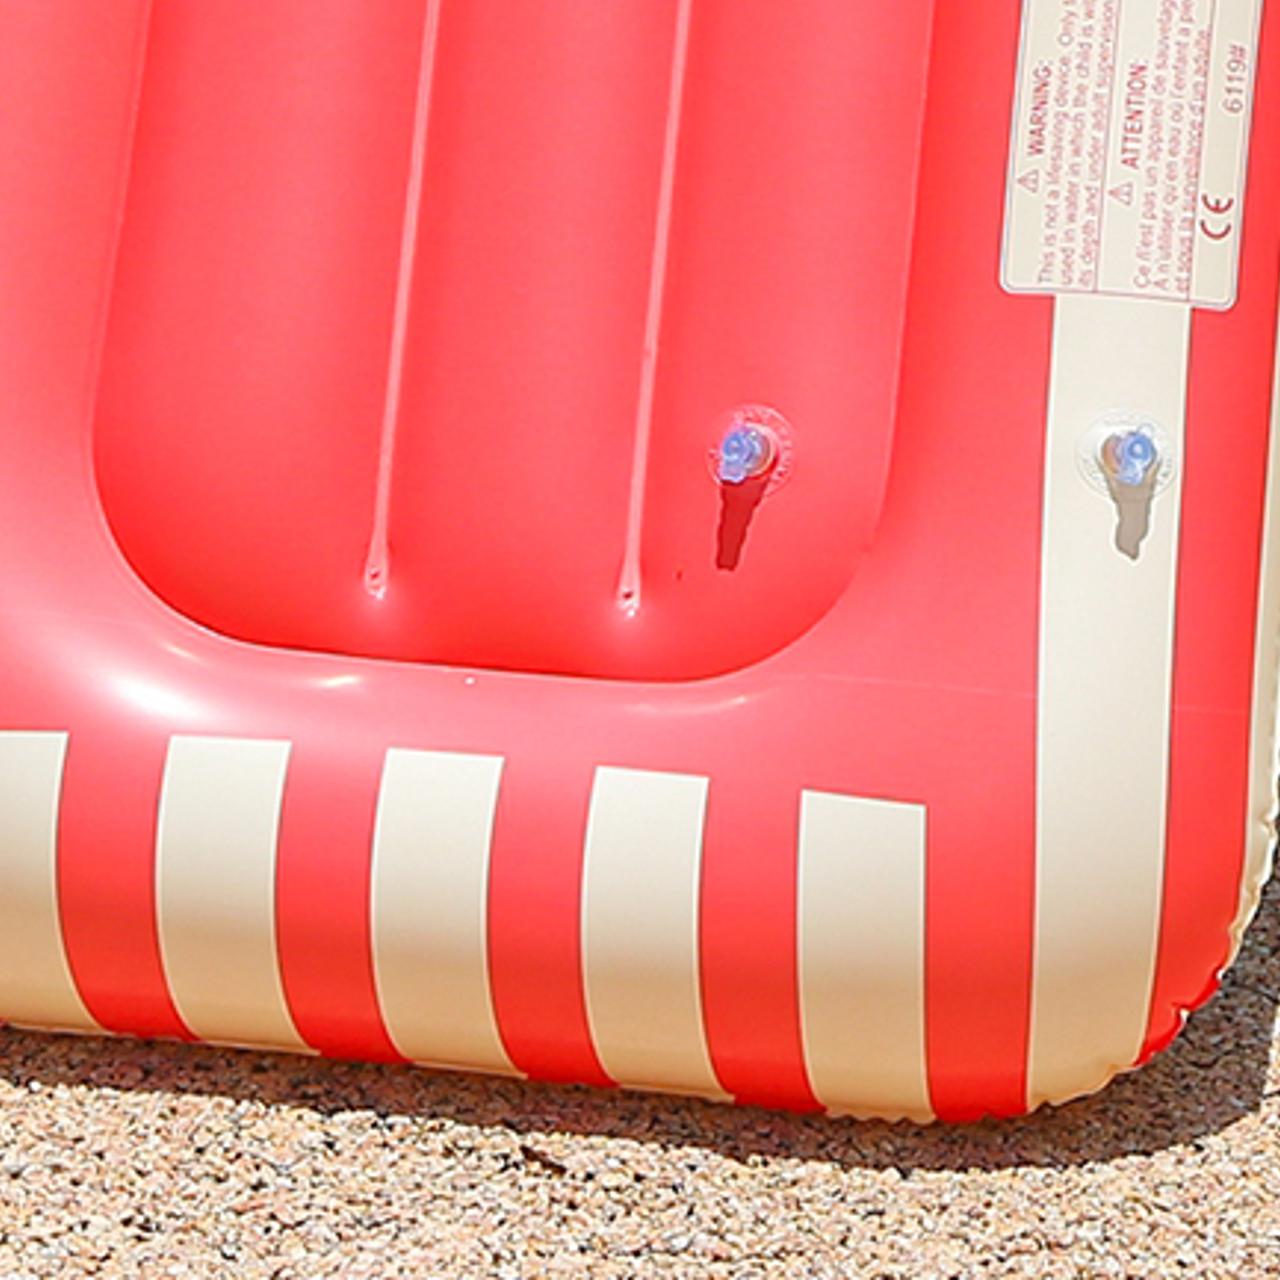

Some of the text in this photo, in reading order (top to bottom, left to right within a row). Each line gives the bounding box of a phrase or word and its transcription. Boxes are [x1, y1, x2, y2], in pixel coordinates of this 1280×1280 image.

[1056, 11, 1078, 46] Only
[1079, 24, 1093, 36] is
[1075, 41, 1091, 78] child
[1223, 44, 1247, 113] 6119#
[1029, 58, 1052, 157] WARNING:
[1072, 83, 1088, 107] the
[1121, 60, 1147, 169] ATTENTION:
[1069, 112, 1085, 156] which
[1067, 163, 1081, 175] in
[1047, 189, 1059, 199] a
[1063, 180, 1079, 222] water
[1083, 185, 1098, 215] and
[1042, 203, 1058, 229] not
[1042, 233, 1056, 246] is
[1061, 228, 1075, 242] in
[1037, 251, 1054, 283] This
[1057, 247, 1074, 284] used
